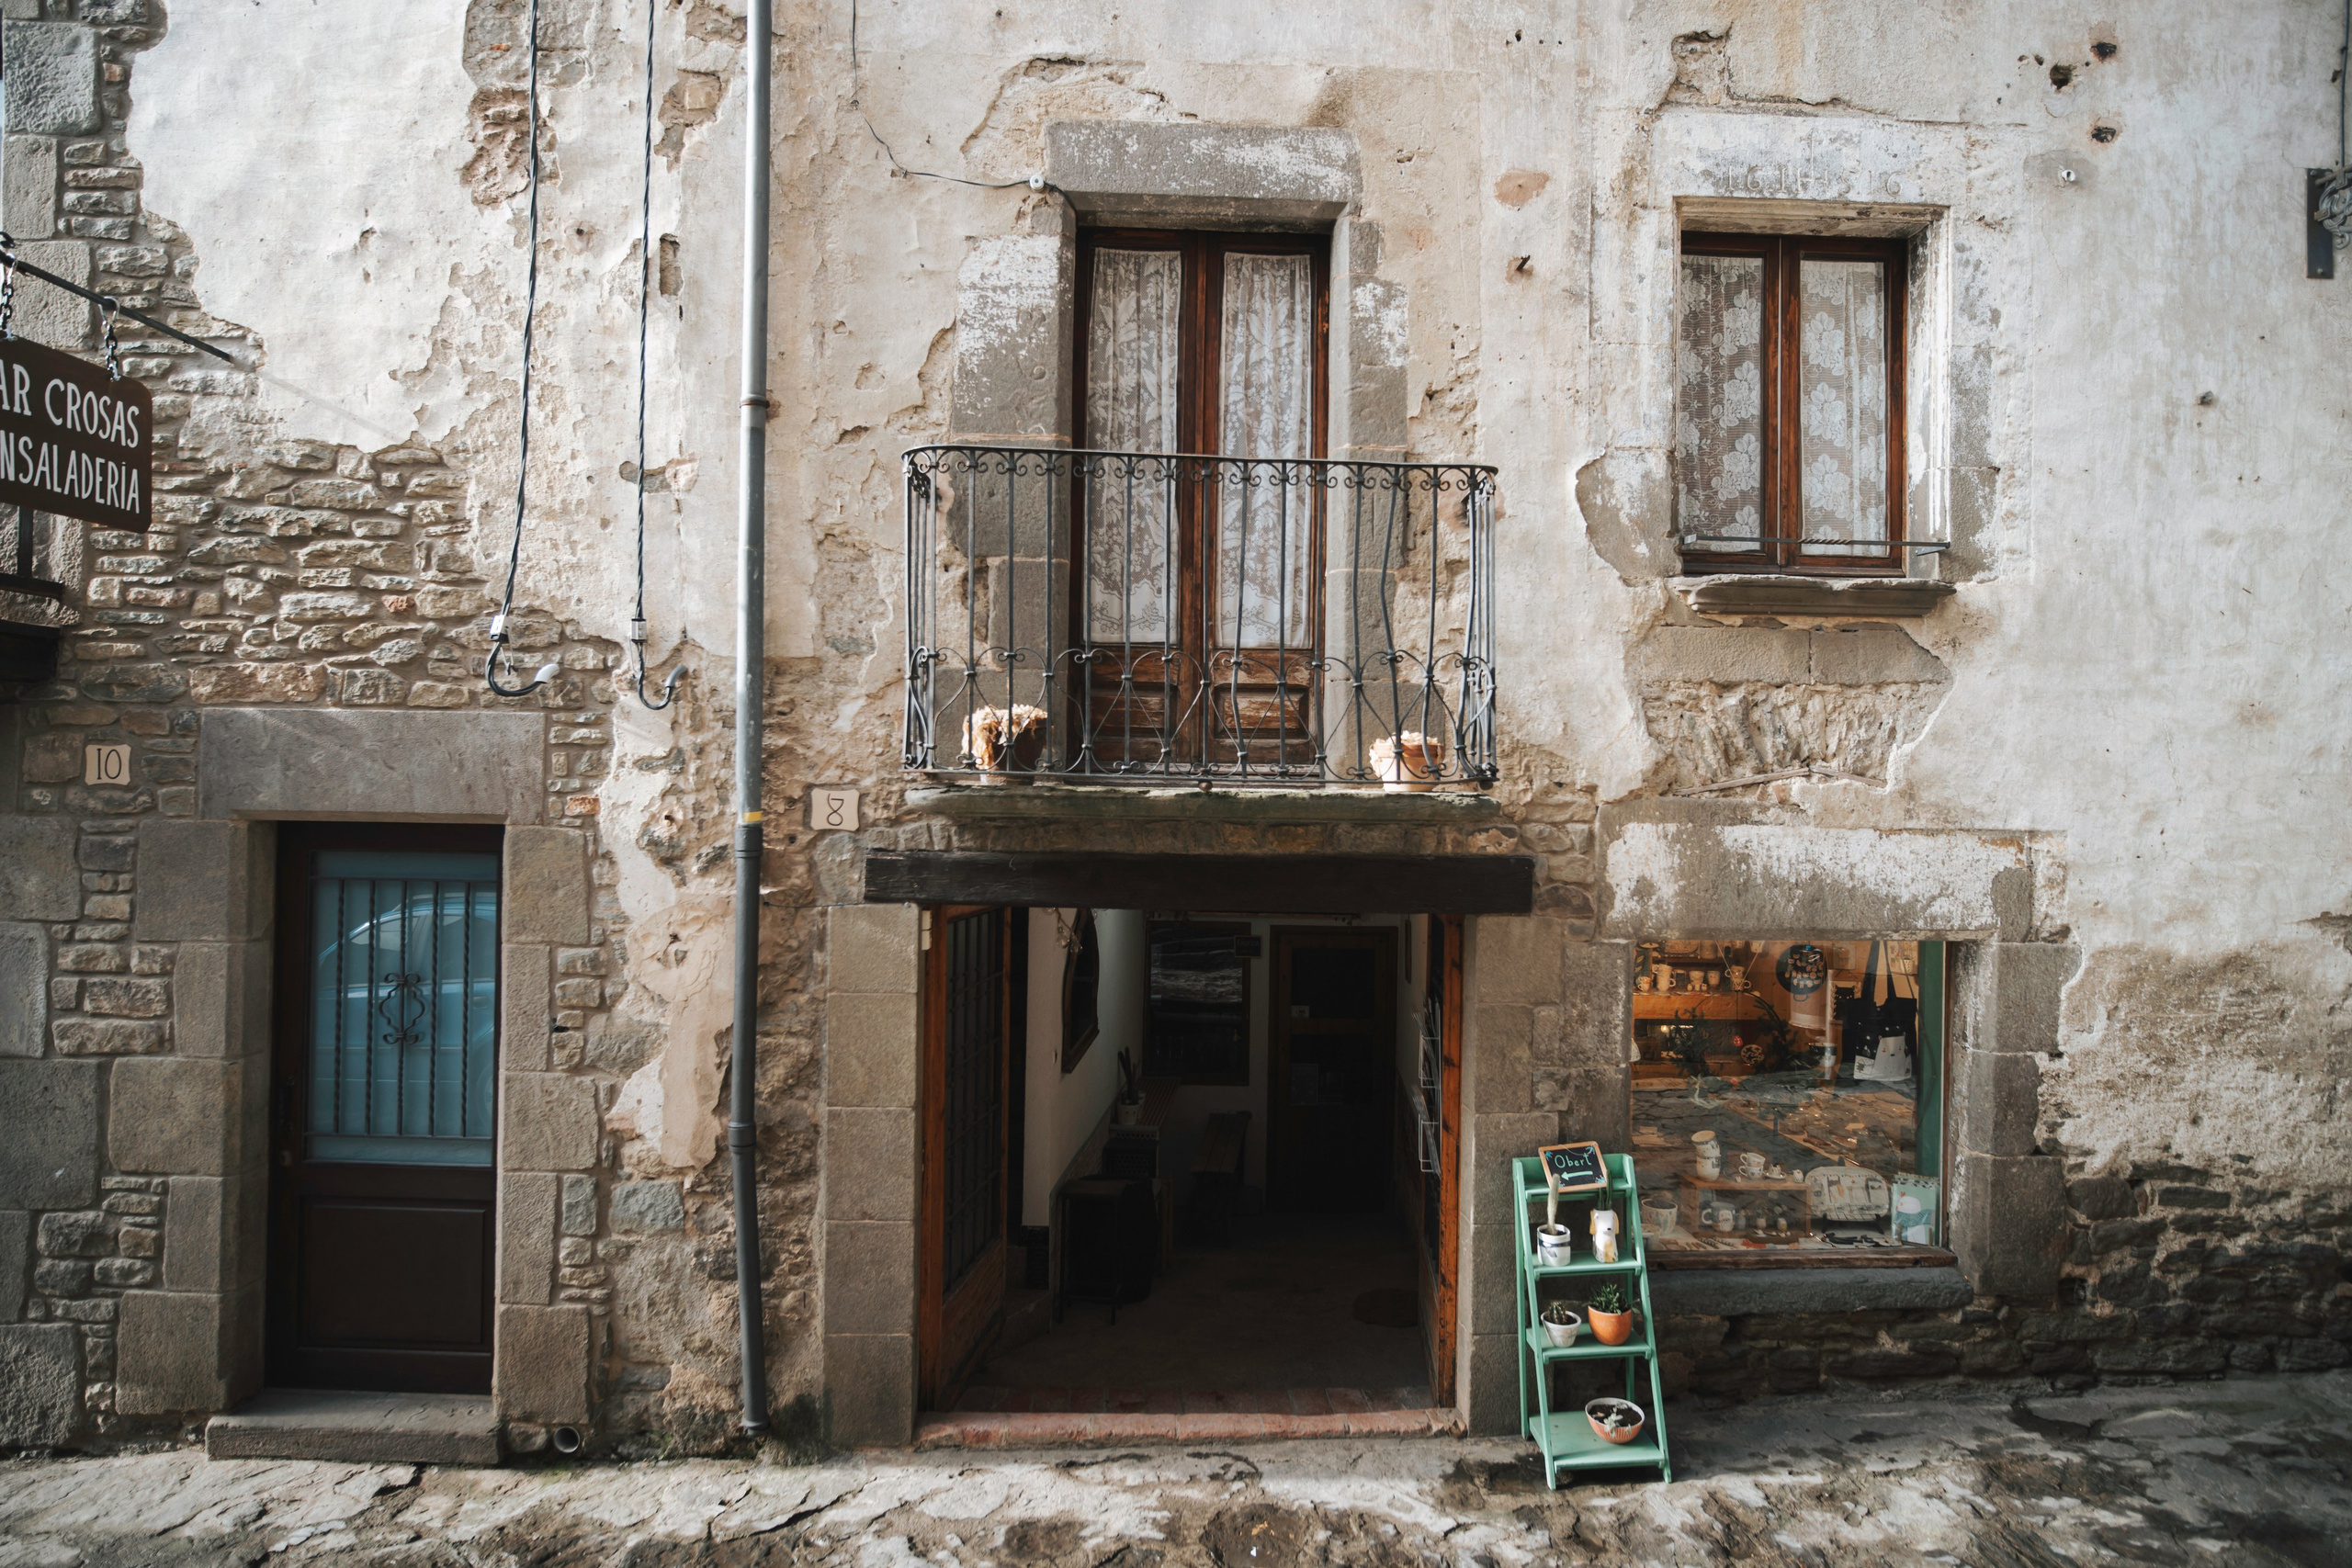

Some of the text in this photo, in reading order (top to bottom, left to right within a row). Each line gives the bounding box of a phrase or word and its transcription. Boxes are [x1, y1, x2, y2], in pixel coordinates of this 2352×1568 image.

[44, 378, 140, 448] CROSAS
[96, 748, 122, 780] 10
[827, 793, 844, 826] 8
[1555, 1152, 1591, 1168] Obert
